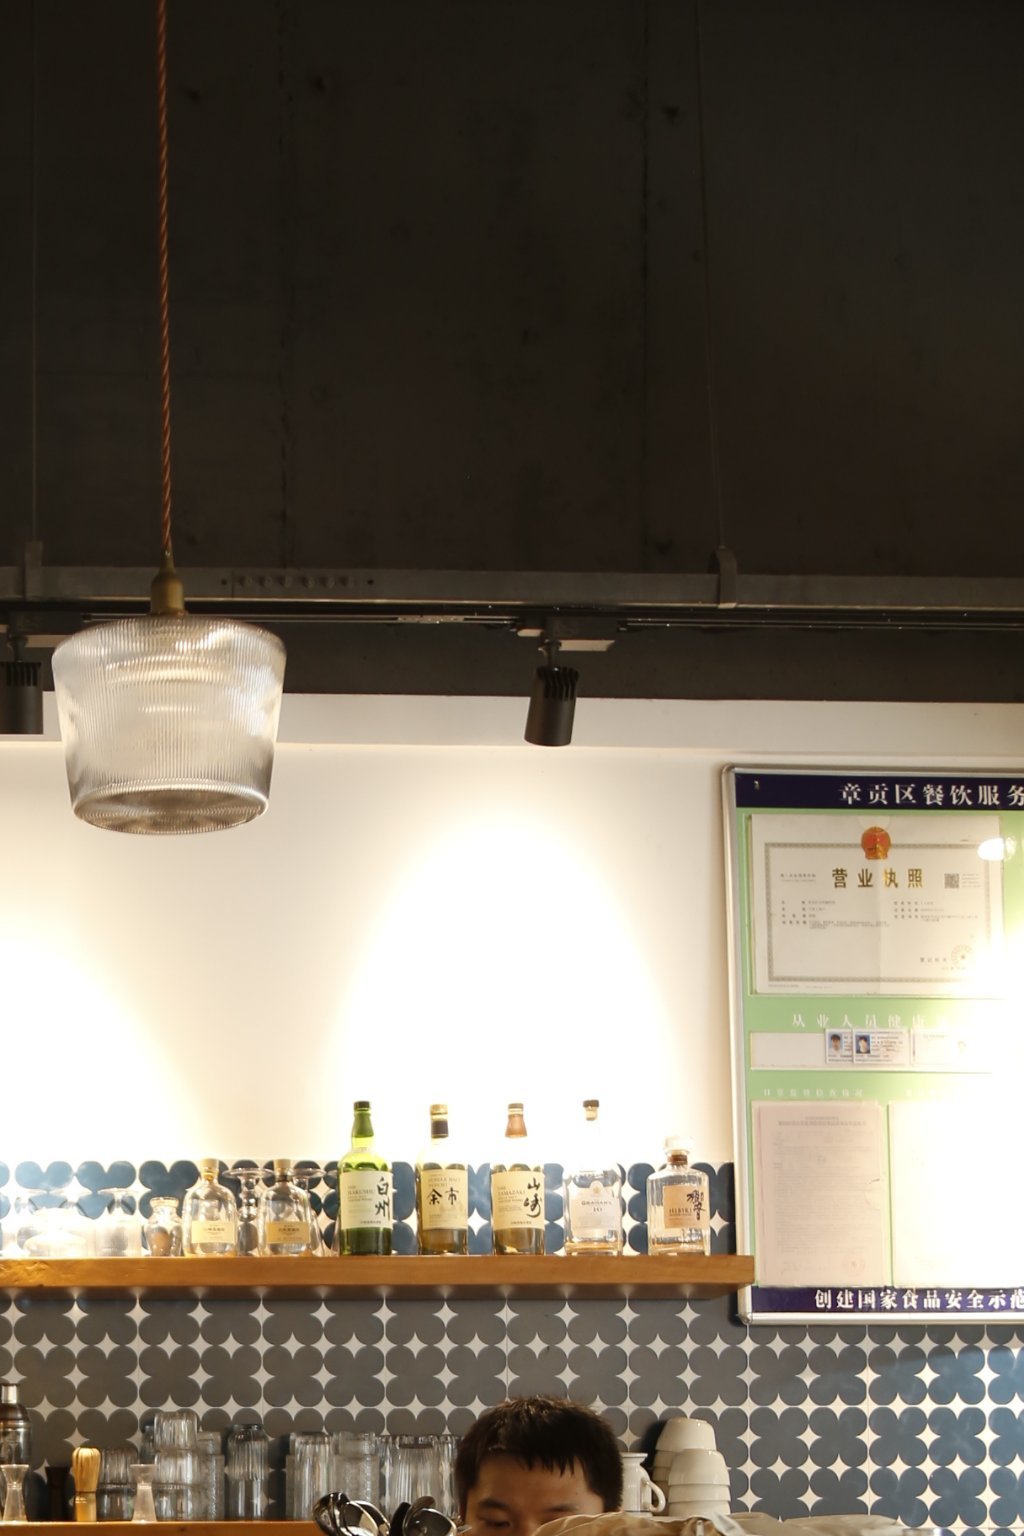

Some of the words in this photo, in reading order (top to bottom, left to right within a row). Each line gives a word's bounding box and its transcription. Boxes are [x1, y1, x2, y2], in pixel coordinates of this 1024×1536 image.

[840, 783, 1024, 807] 章贡区餐饮服务
[832, 868, 923, 889] 营业执照
[374, 1176, 391, 1222] 白州
[426, 1186, 460, 1206] 余市
[815, 1289, 1024, 1310] 创建国家食品安全示范
